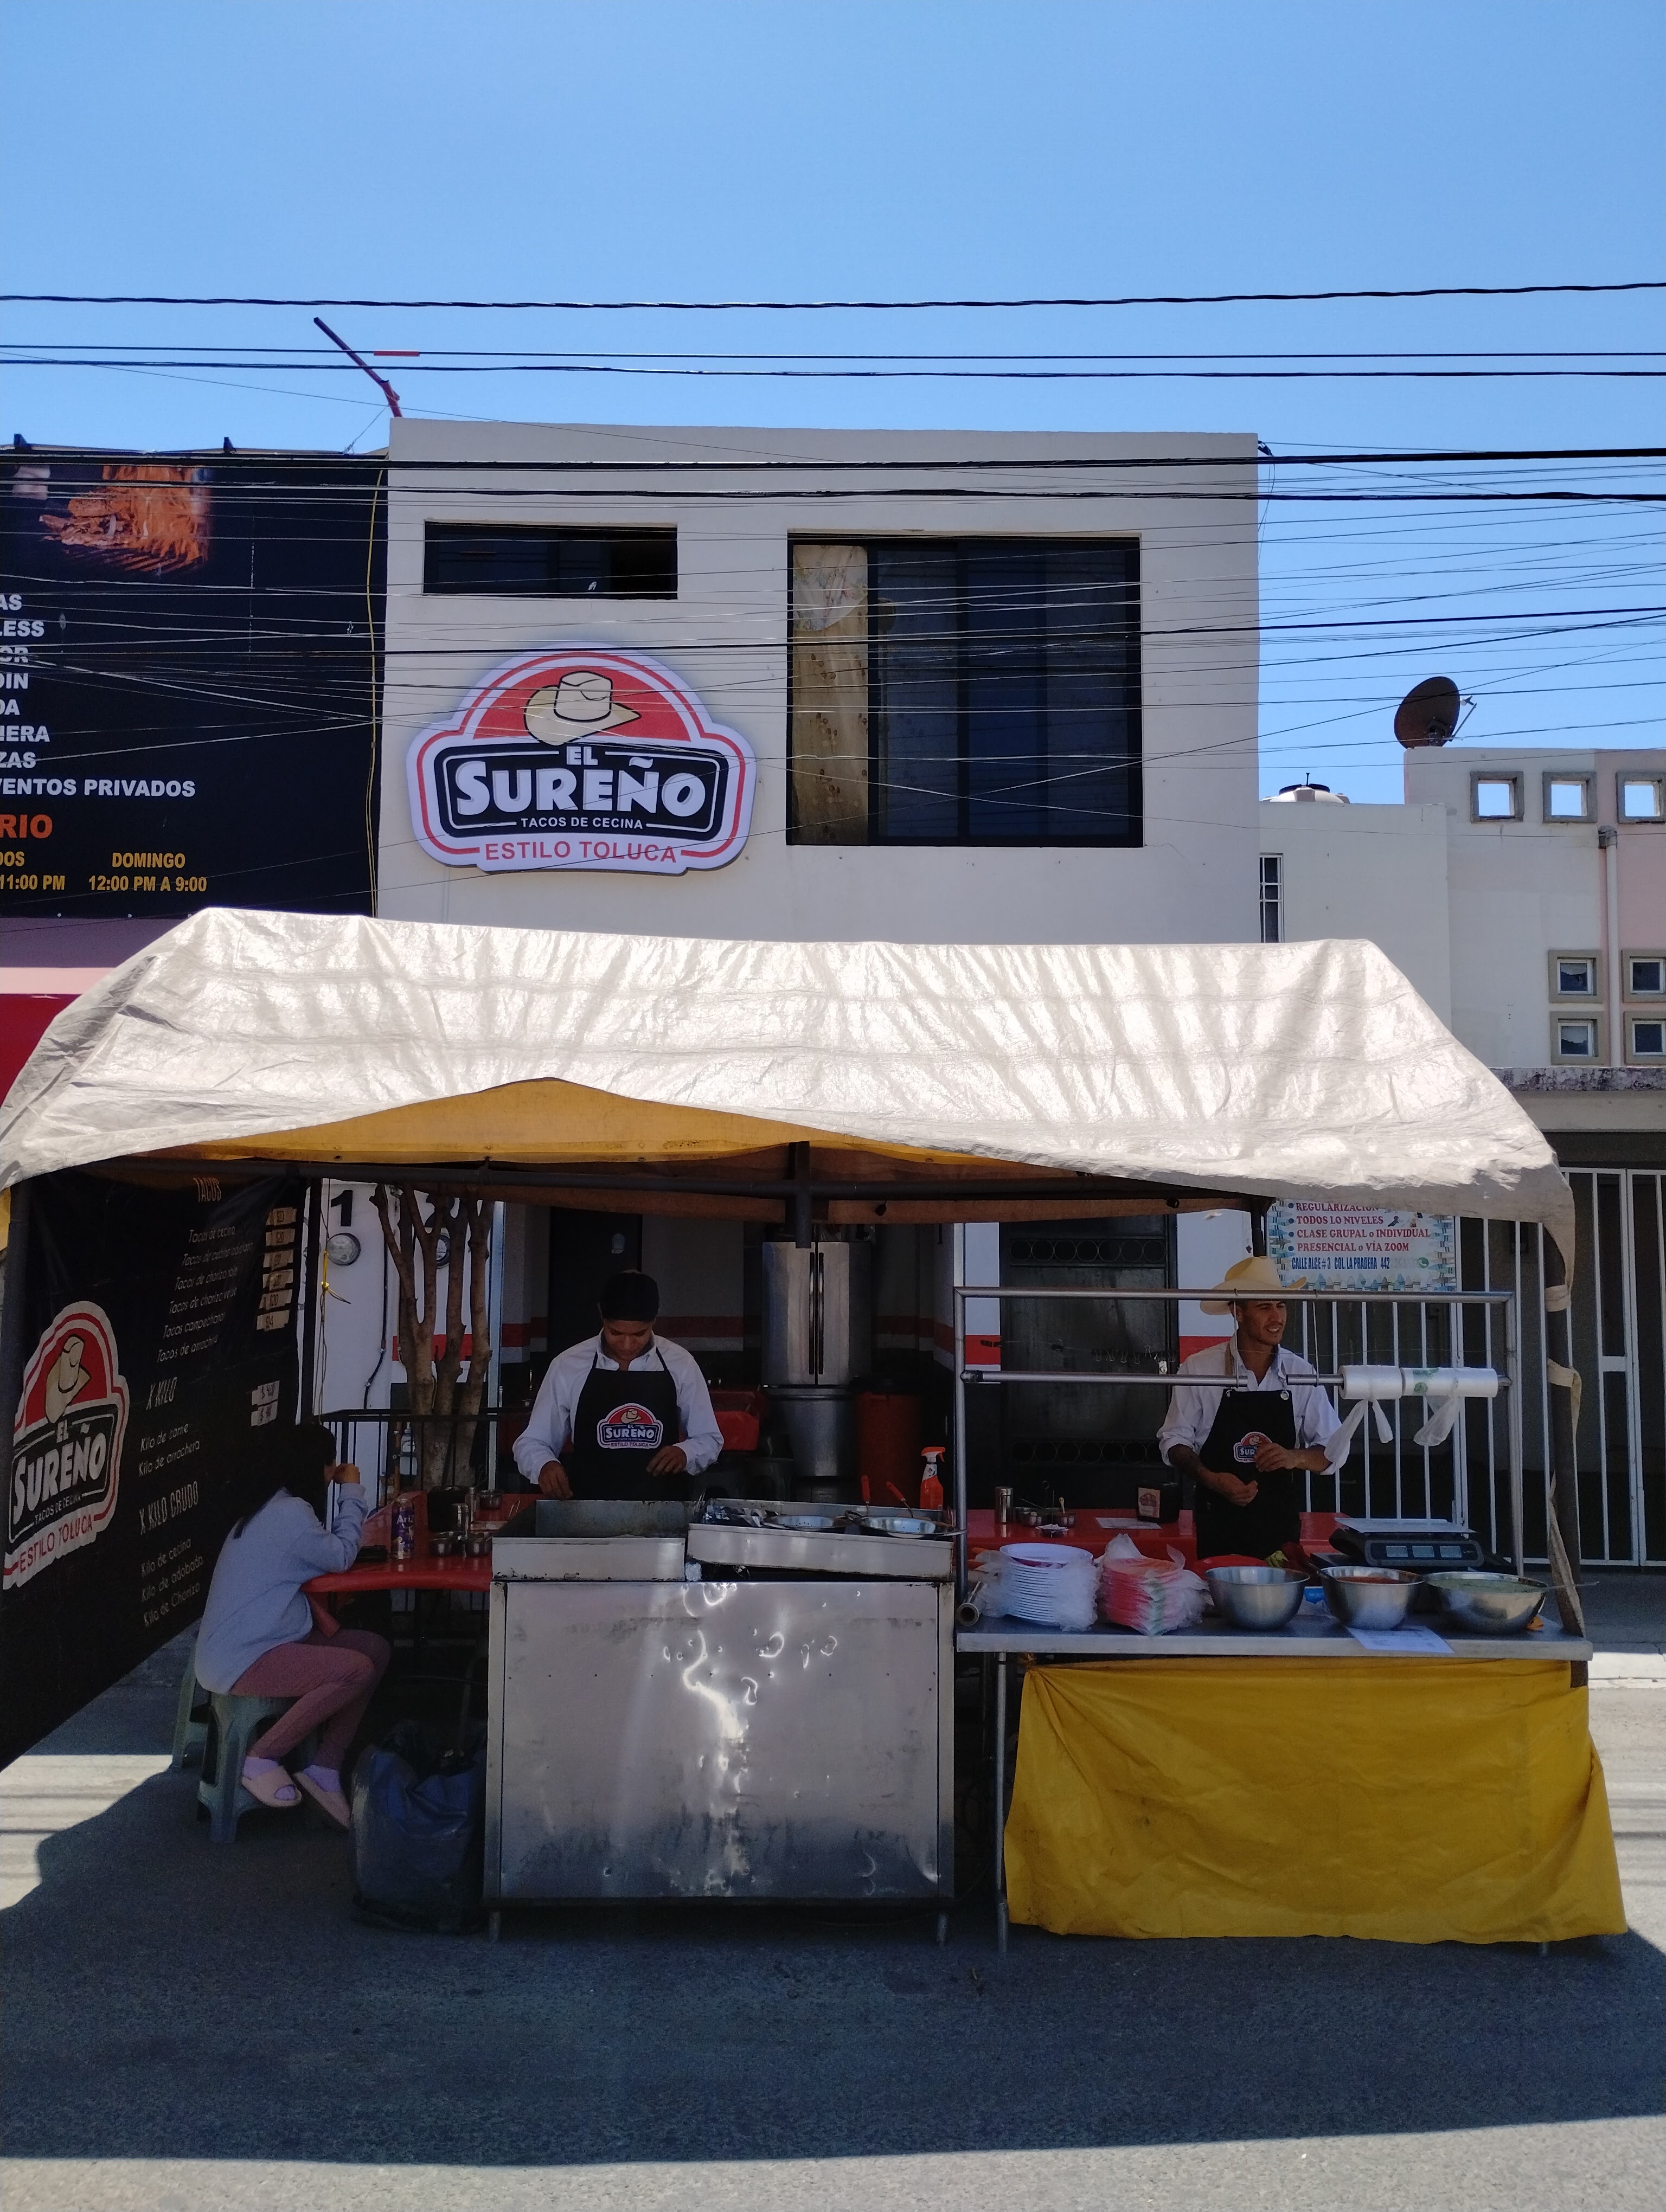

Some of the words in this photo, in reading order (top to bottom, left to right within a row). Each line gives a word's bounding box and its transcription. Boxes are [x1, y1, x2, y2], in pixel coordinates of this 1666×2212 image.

[566, 746, 598, 766] EL
[0, 778, 77, 796] ENTOS
[84, 779, 196, 798] PRIVADOS
[454, 756, 706, 818] SUREÑO
[520, 817, 567, 828] TACOS
[570, 817, 588, 828] DE
[591, 817, 644, 830] CECINA
[112, 852, 186, 869] DOMINGO
[484, 840, 571, 861] ESTILO
[579, 840, 678, 864] TOLUCA
[42, 874, 66, 891] PM
[88, 874, 129, 891] 12:00
[133, 875, 156, 891] PM
[159, 876, 171, 891] A
[175, 876, 208, 892] 9:00
[192, 1177, 222, 1203] TACOS
[330, 1189, 354, 1227] 1
[1296, 1216, 1329, 1225] TODOS
[1329, 1216, 1342, 1225] LO
[1343, 1216, 1385, 1225] NIVELES
[1296, 1229, 1328, 1238] CLASE
[1329, 1229, 1367, 1238] GRUPAL
[1376, 1229, 1432, 1238] INDIVIDUAL
[1296, 1243, 1356, 1252] PRESENCIAL
[1364, 1240, 1383, 1252] VÍA
[1385, 1243, 1409, 1252] ZOOM
[1291, 1257, 1308, 1270] CALLE
[1308, 1257, 1321, 1270] ALCE
[1334, 1257, 1347, 1270] COL.
[1347, 1257, 1353, 1270] LA
[1354, 1257, 1378, 1270] PRADERA
[156, 1348, 178, 1364] Tacos
[145, 1382, 156, 1411] X
[155, 1376, 178, 1407] KILO
[56, 1419, 69, 1444] EL
[140, 1437, 156, 1452] Kilo
[157, 1430, 167, 1445] de
[168, 1423, 189, 1441] carne
[605, 1426, 655, 1439] SUREÑO
[139, 1461, 153, 1477] Kilo
[155, 1455, 165, 1470] de
[166, 1440, 201, 1464] arrachera
[12, 1423, 107, 1525] SUREÑO
[139, 1507, 146, 1536] X
[148, 1496, 168, 1531] KILO
[170, 1480, 199, 1518] CRUDO
[19, 1532, 55, 1574] ESTILO
[59, 1514, 93, 1546] TOLUCA
[140, 1559, 156, 1578] Kilo
[157, 1553, 168, 1567] de
[141, 1585, 156, 1603] Kilo
[143, 1608, 159, 1627] Kilo
